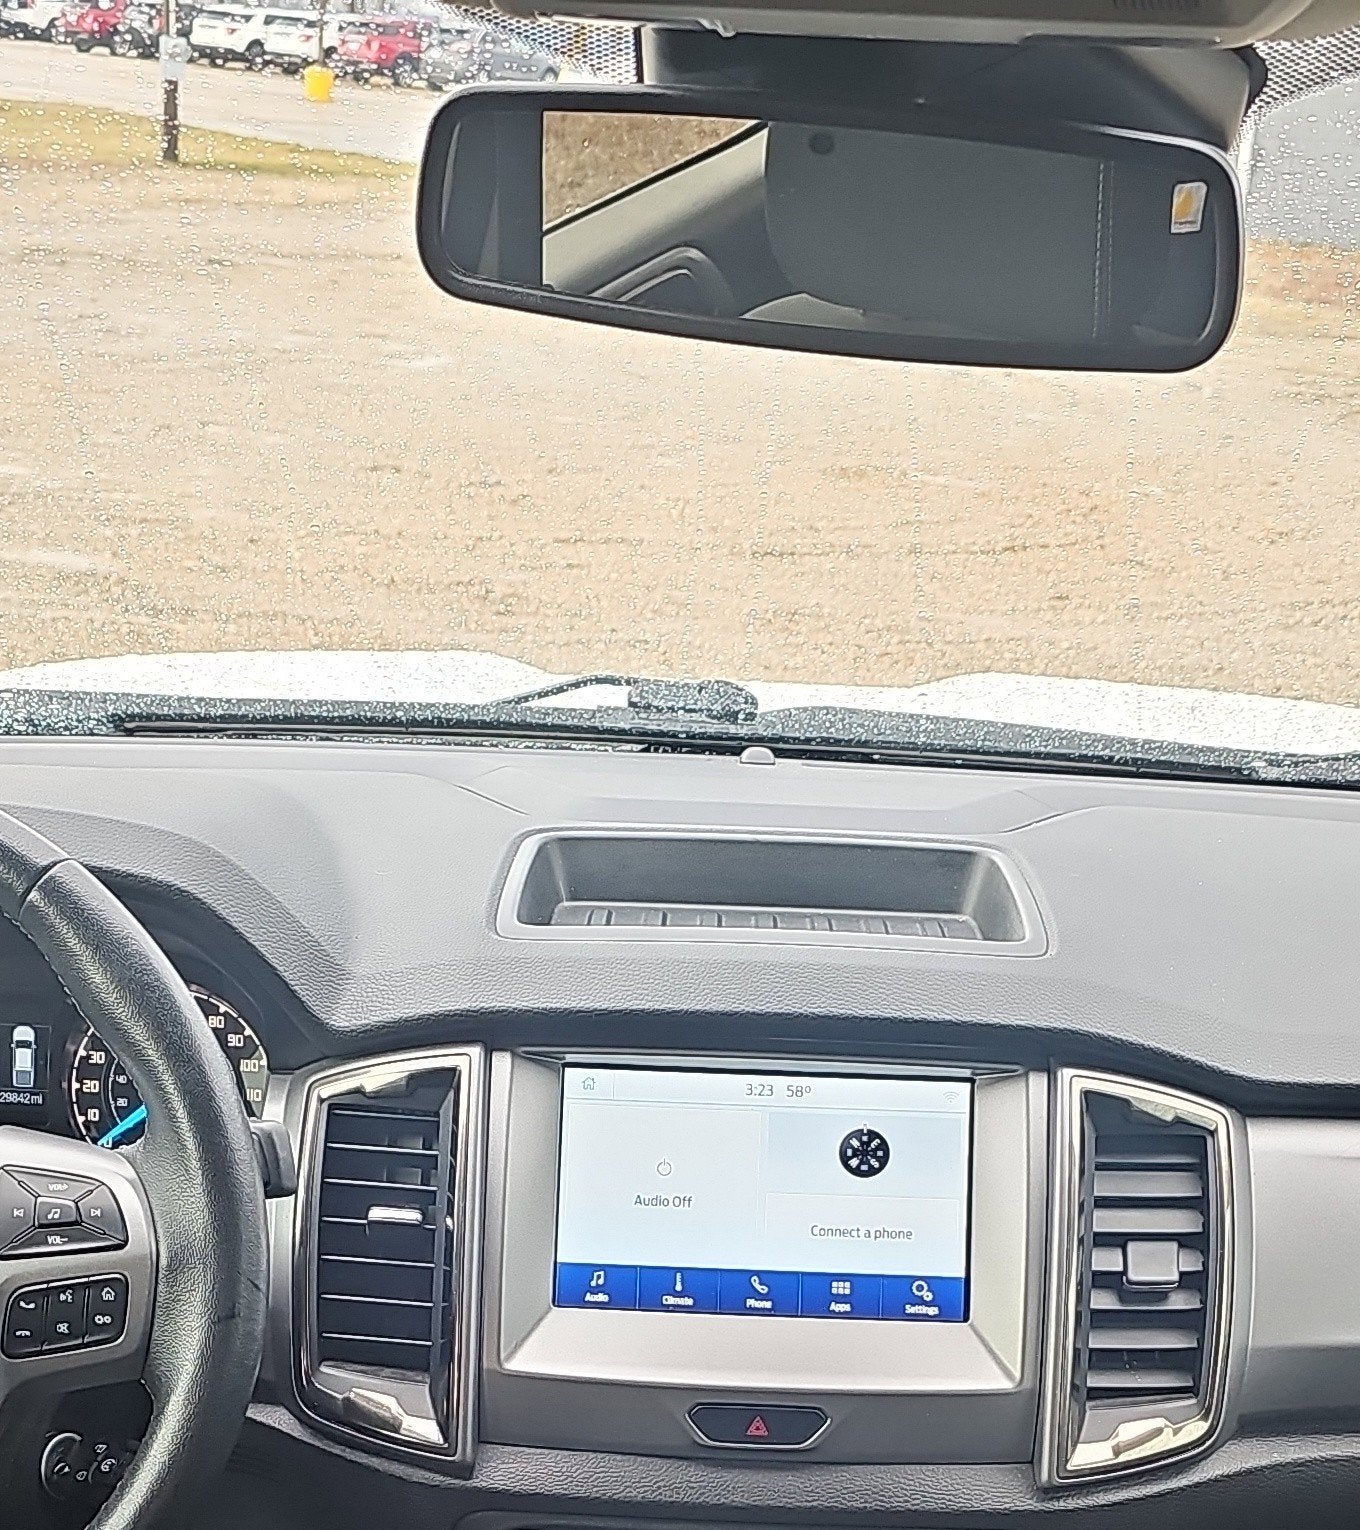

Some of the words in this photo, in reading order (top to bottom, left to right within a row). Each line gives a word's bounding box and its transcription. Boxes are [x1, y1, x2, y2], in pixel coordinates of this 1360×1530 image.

[208, 1016, 225, 1029] 80
[227, 1033, 244, 1047] 90
[88, 1051, 106, 1064] 30
[240, 1059, 258, 1072] 100
[82, 1080, 100, 1093] 20
[745, 1082, 774, 1098] 3:23
[246, 1089, 262, 1102] 110
[87, 1108, 100, 1121] 10
[634, 1194, 670, 1208] Audio
[672, 1195, 693, 1209] Off
[810, 1224, 861, 1239] Connect
[863, 1229, 872, 1239] a
[874, 1226, 913, 1242] phone
[584, 1292, 610, 1303] Audio
[662, 1295, 695, 1307] Climate
[746, 1298, 773, 1310] Phone
[829, 1301, 852, 1313] Apps
[904, 1304, 939, 1316] Settings
